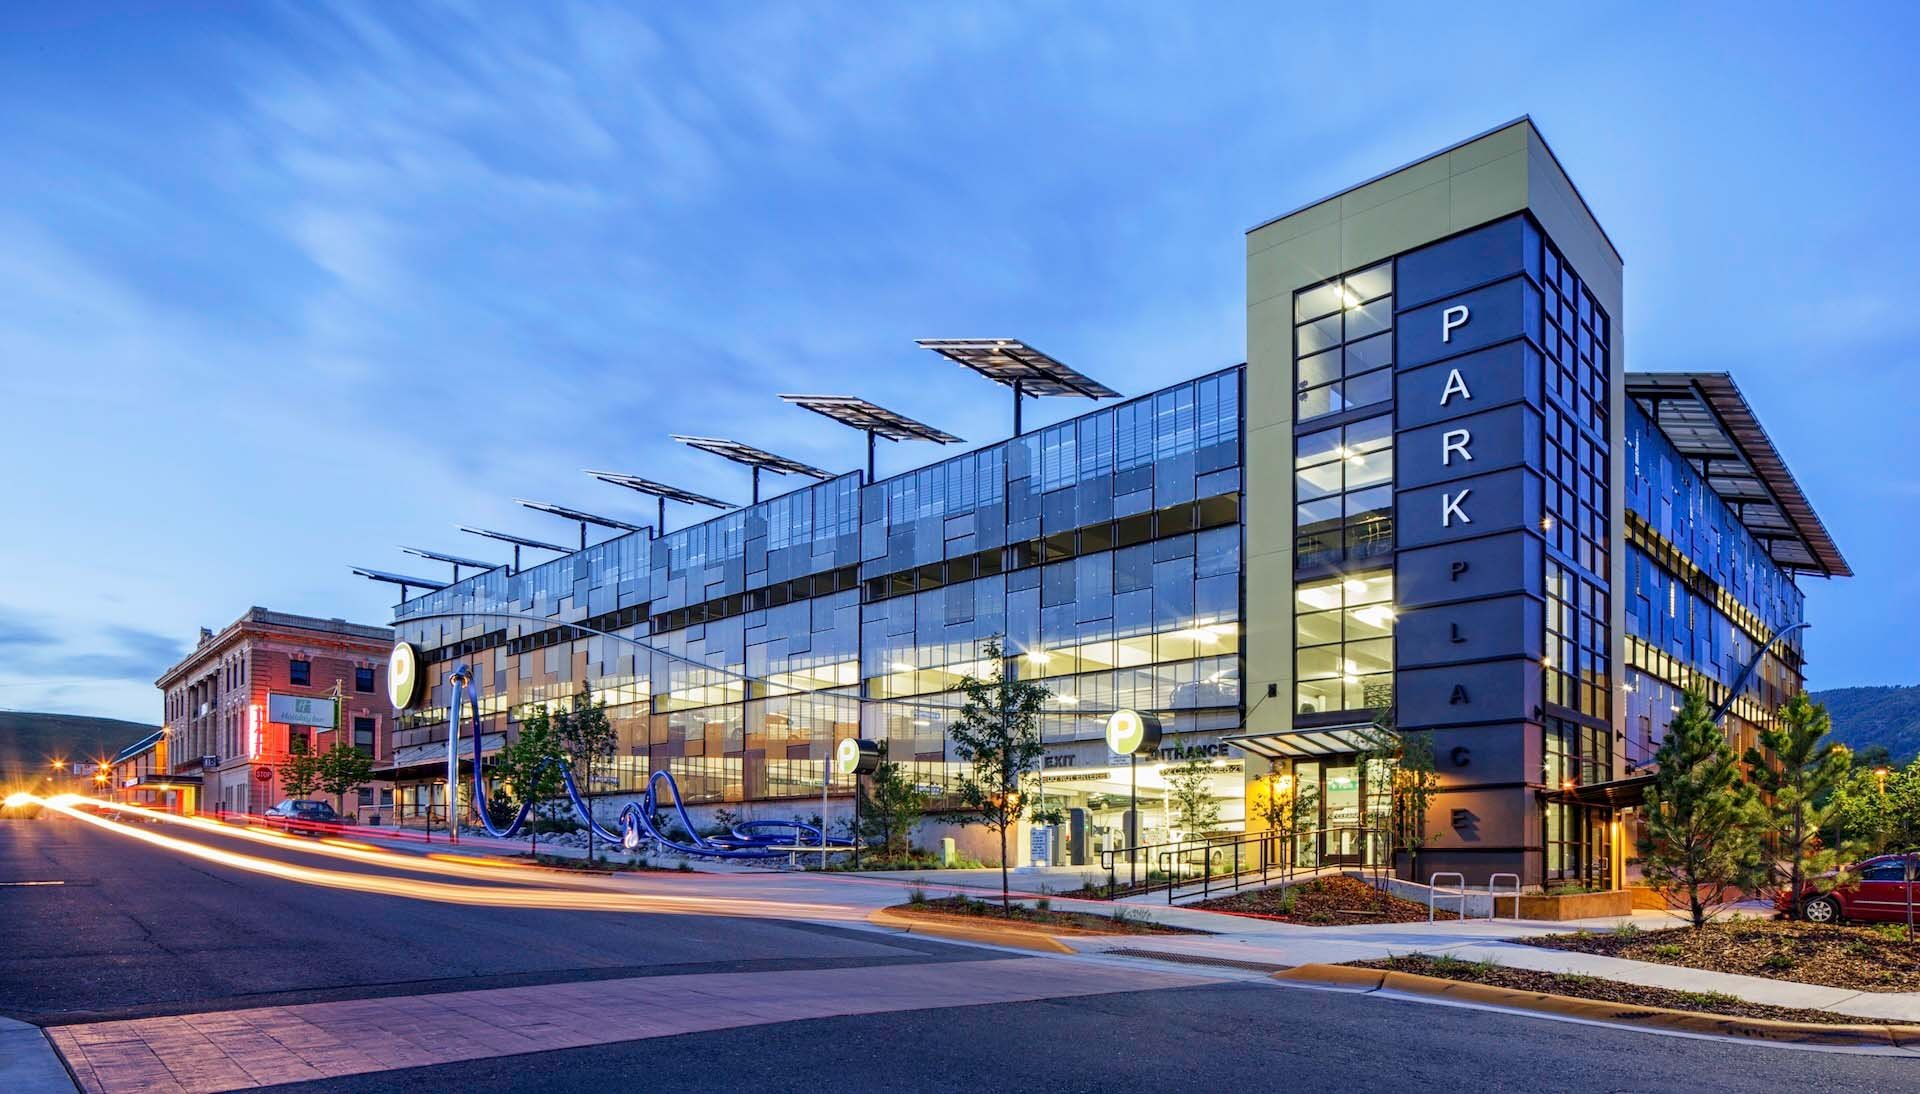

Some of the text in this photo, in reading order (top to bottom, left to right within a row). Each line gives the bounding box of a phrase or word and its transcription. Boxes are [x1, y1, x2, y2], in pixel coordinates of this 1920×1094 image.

[1440, 305, 1472, 829] PARK PLACE
[391, 648, 410, 705] P
[1110, 713, 1136, 752] P
[838, 741, 855, 773] P
[1044, 754, 1076, 768] EXIT
